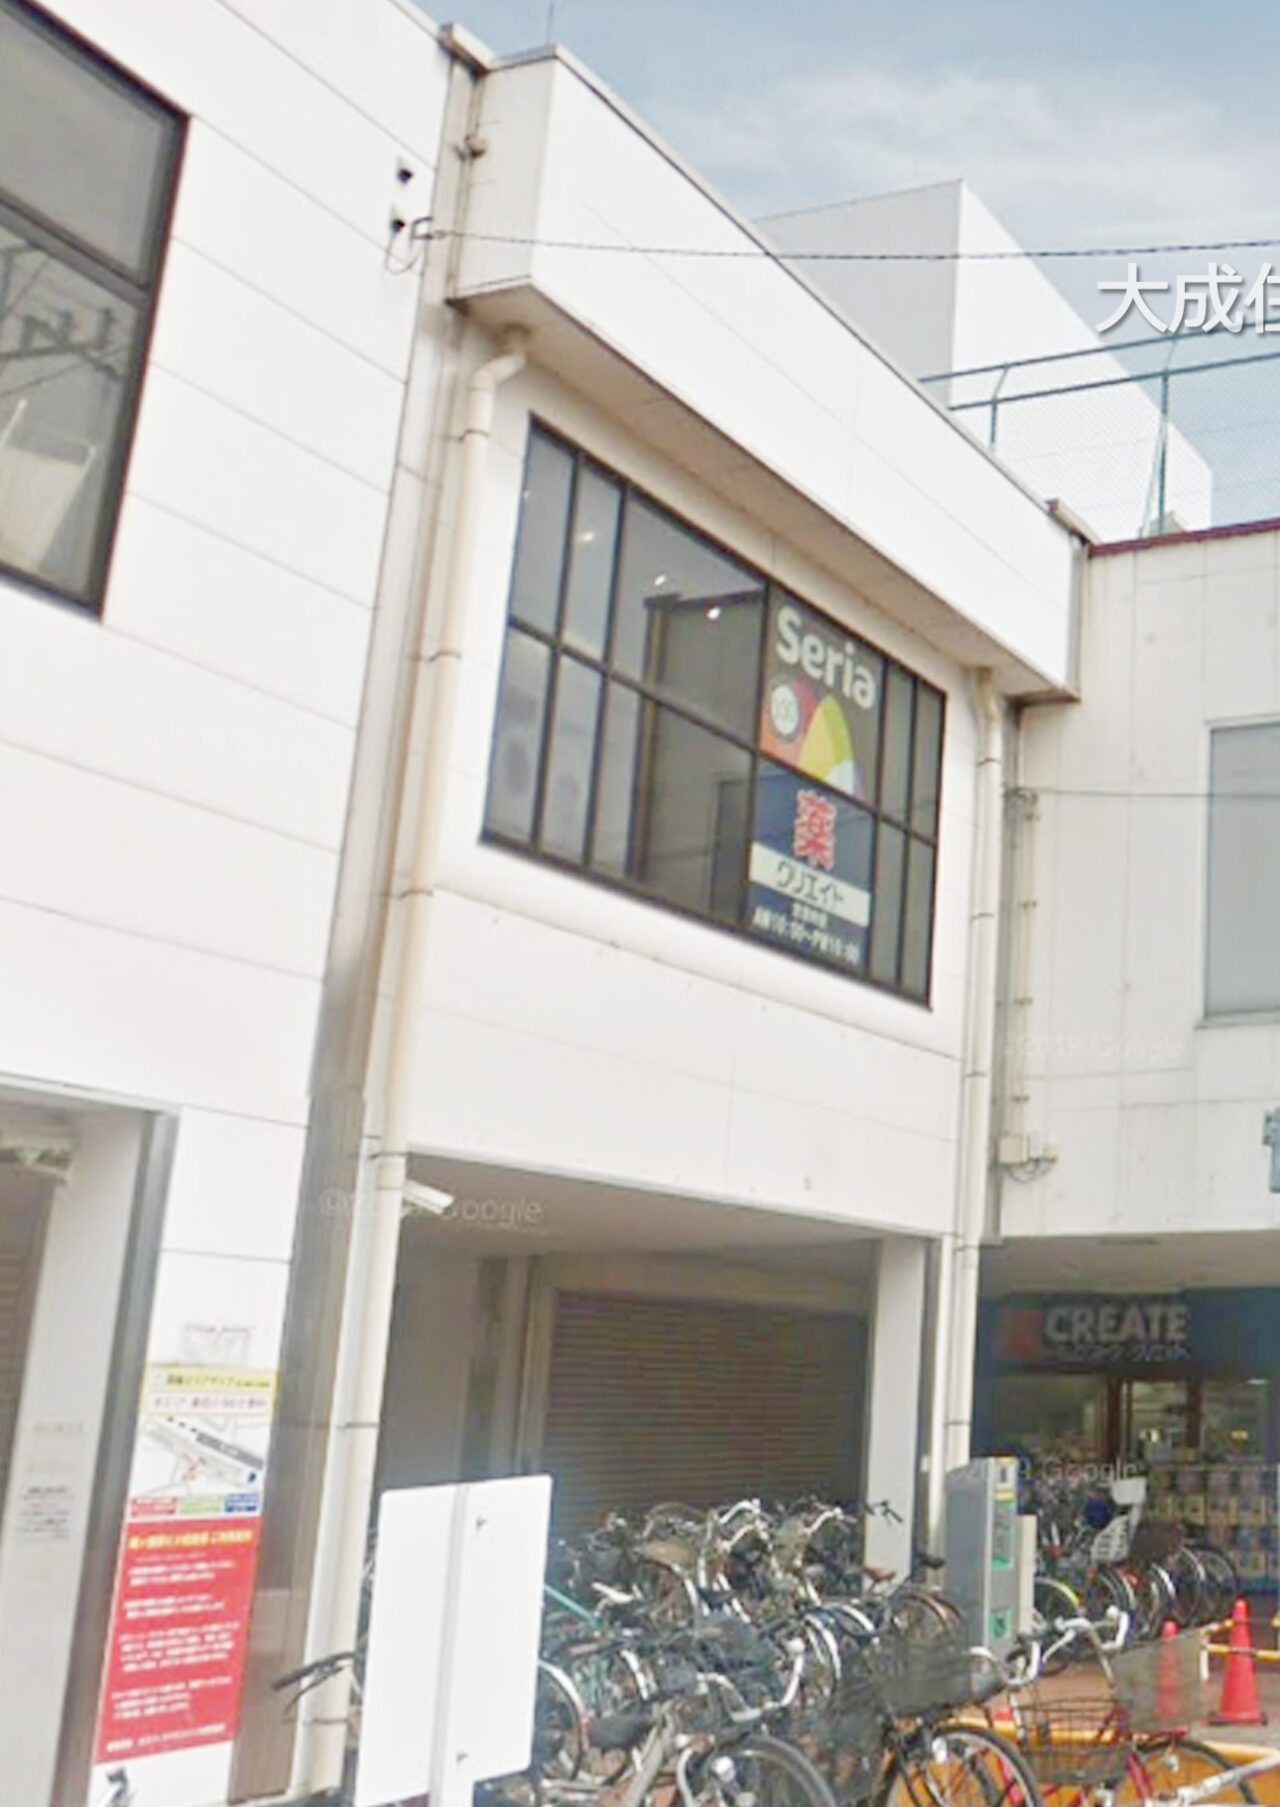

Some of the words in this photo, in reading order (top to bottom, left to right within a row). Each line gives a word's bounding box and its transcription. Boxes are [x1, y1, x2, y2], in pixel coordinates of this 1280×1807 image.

[776, 605, 876, 709] Seria
[794, 789, 837, 872] 薬
[1045, 1302, 1190, 1342] CREATE
